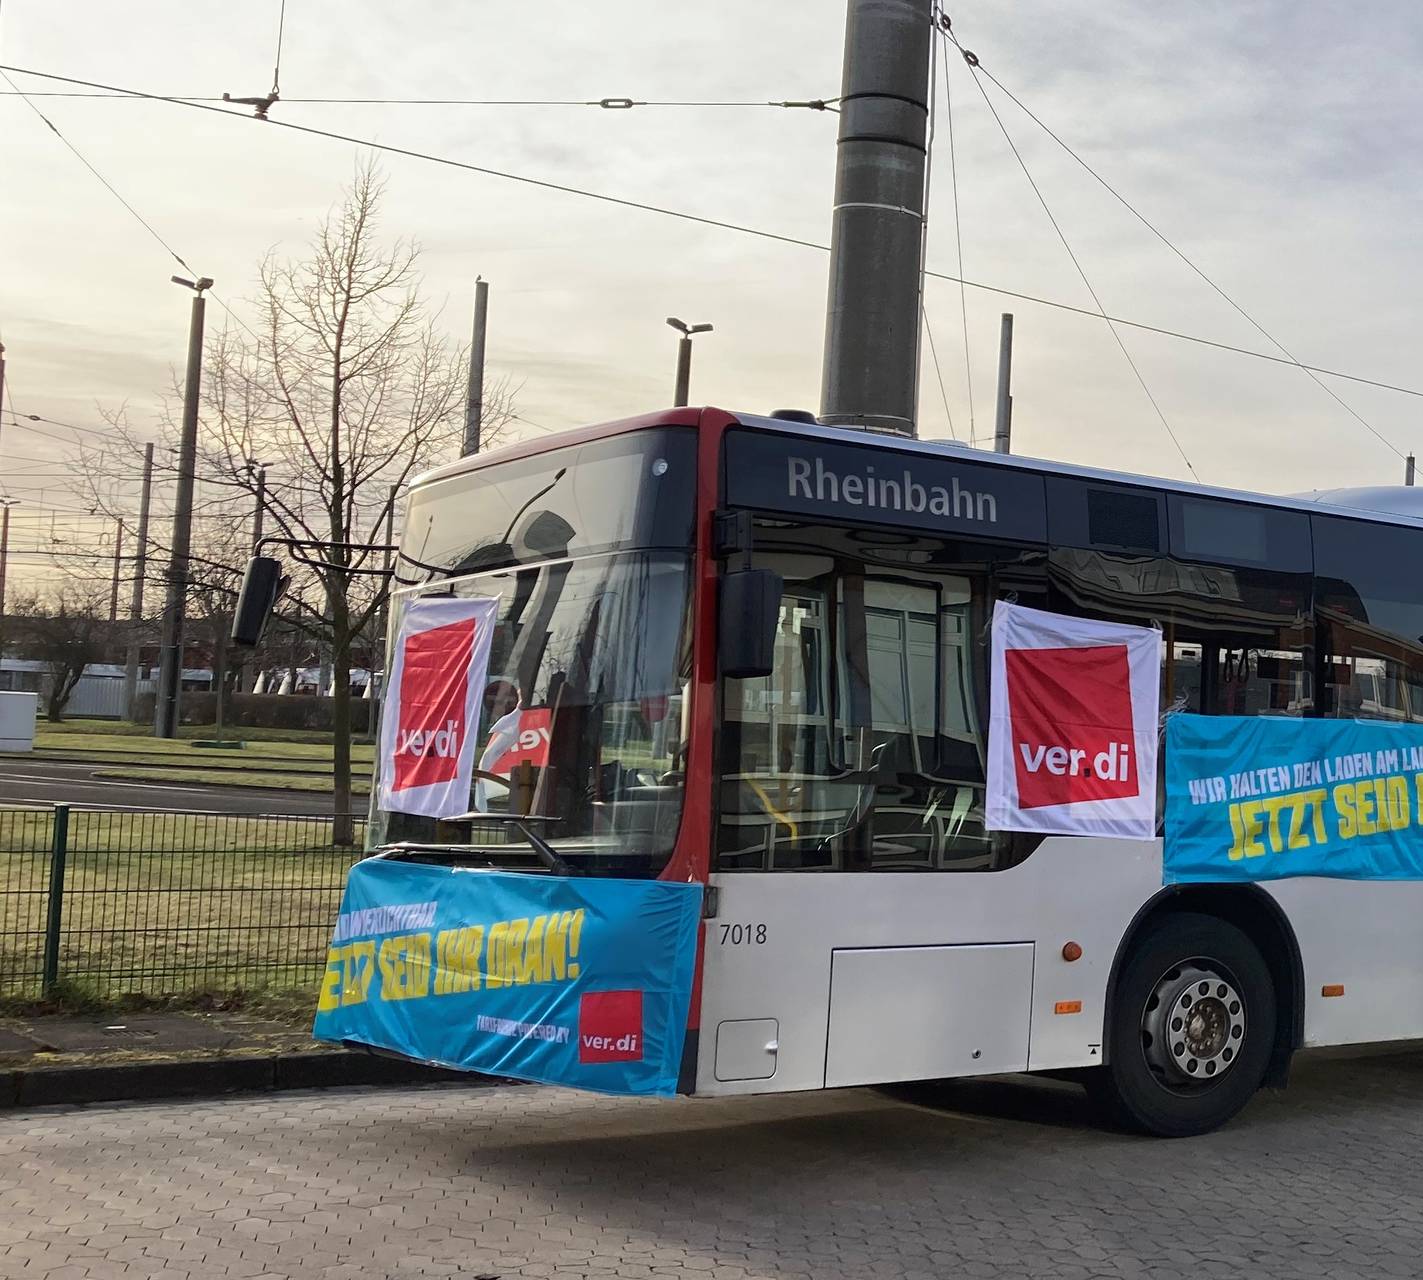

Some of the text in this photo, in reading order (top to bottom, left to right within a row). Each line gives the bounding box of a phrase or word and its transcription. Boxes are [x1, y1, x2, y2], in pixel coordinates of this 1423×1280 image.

[787, 456, 997, 523] Rheinbahn
[400, 719, 460, 759] ver.di
[1019, 742, 1129, 782] ver.di
[1188, 776, 1227, 805] WIR
[1229, 766, 1291, 799] HALTEN
[1293, 760, 1322, 788] DEN
[1324, 752, 1373, 783] LADEN
[1376, 749, 1399, 774] AM
[1228, 788, 1328, 860] JETZT
[1333, 776, 1410, 840] SEID
[378, 933, 432, 1001] SEID
[433, 925, 484, 996] IHR
[486, 908, 585, 989] DRAN!
[720, 924, 767, 945] 7018
[582, 1034, 637, 1052] ver.di
